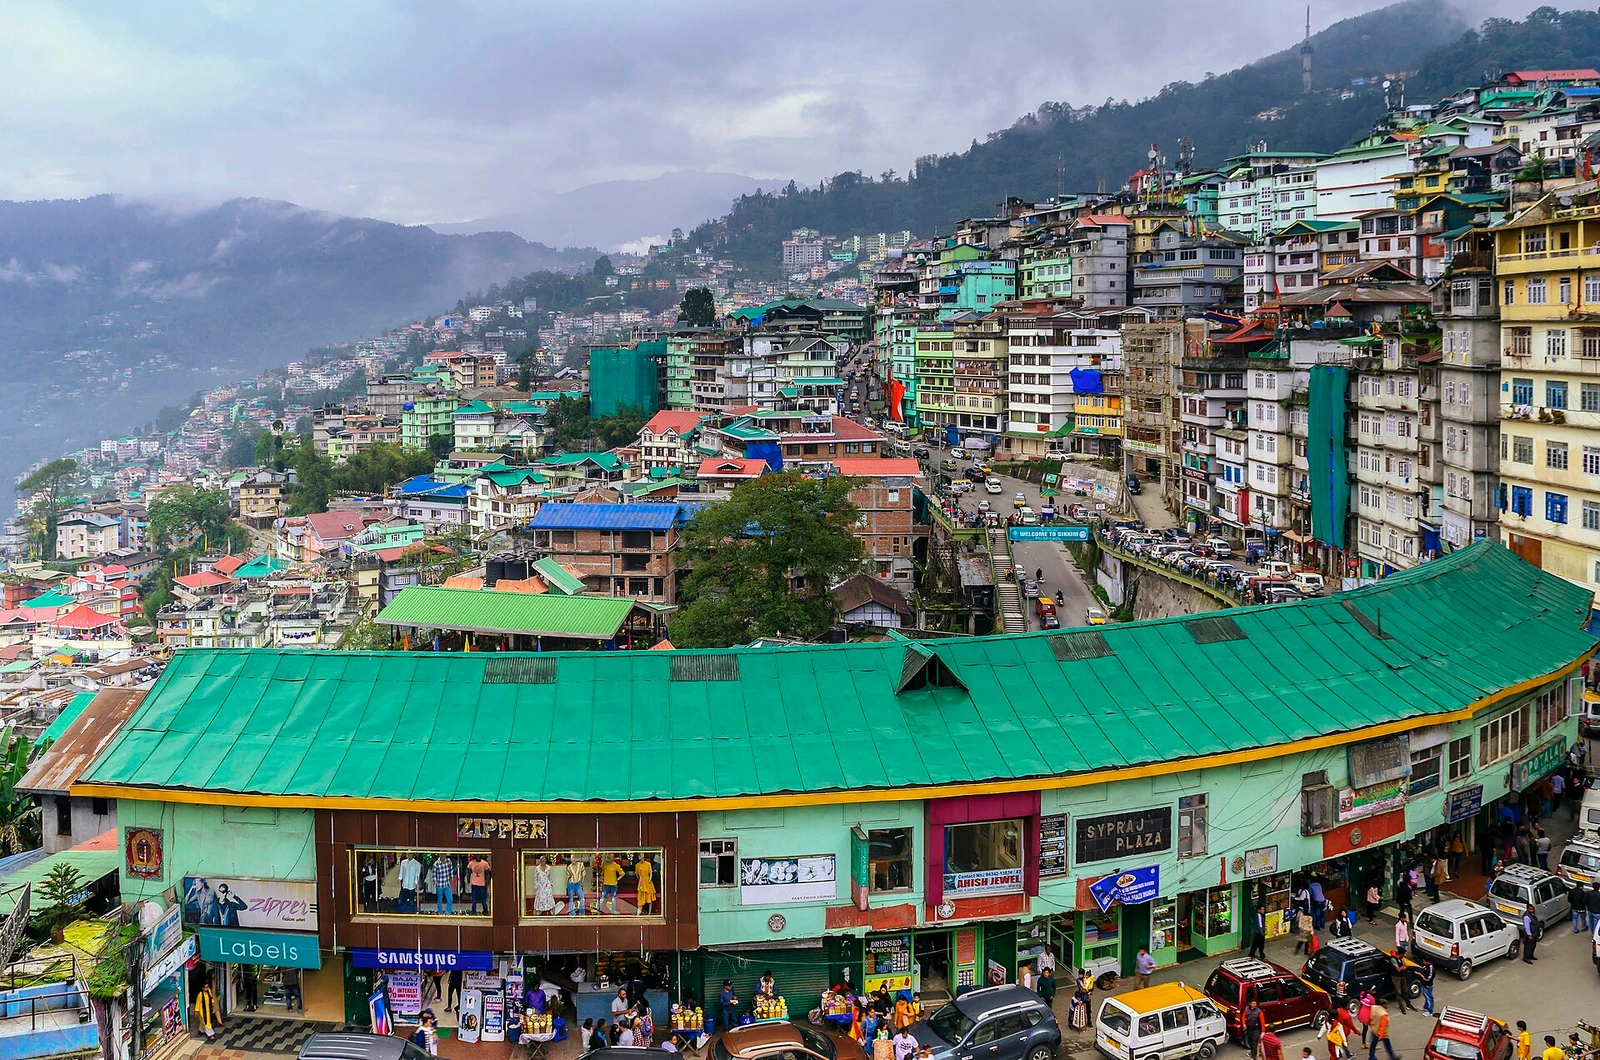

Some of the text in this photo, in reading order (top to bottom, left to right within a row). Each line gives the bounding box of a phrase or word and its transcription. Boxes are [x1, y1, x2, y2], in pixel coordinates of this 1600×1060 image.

[458, 818, 547, 839] ZIPPER
[1086, 818, 1145, 839] SYPRAJ
[1116, 831, 1162, 852] PLAZA
[1248, 865, 1274, 875] COLLECTION
[990, 875, 1021, 885] JEWEL
[248, 897, 310, 918] zipper
[219, 937, 299, 961] Labels
[870, 939, 903, 948] DRESSED
[870, 946, 900, 954] CHICKEN
[378, 952, 457, 966] SAMSUNG
